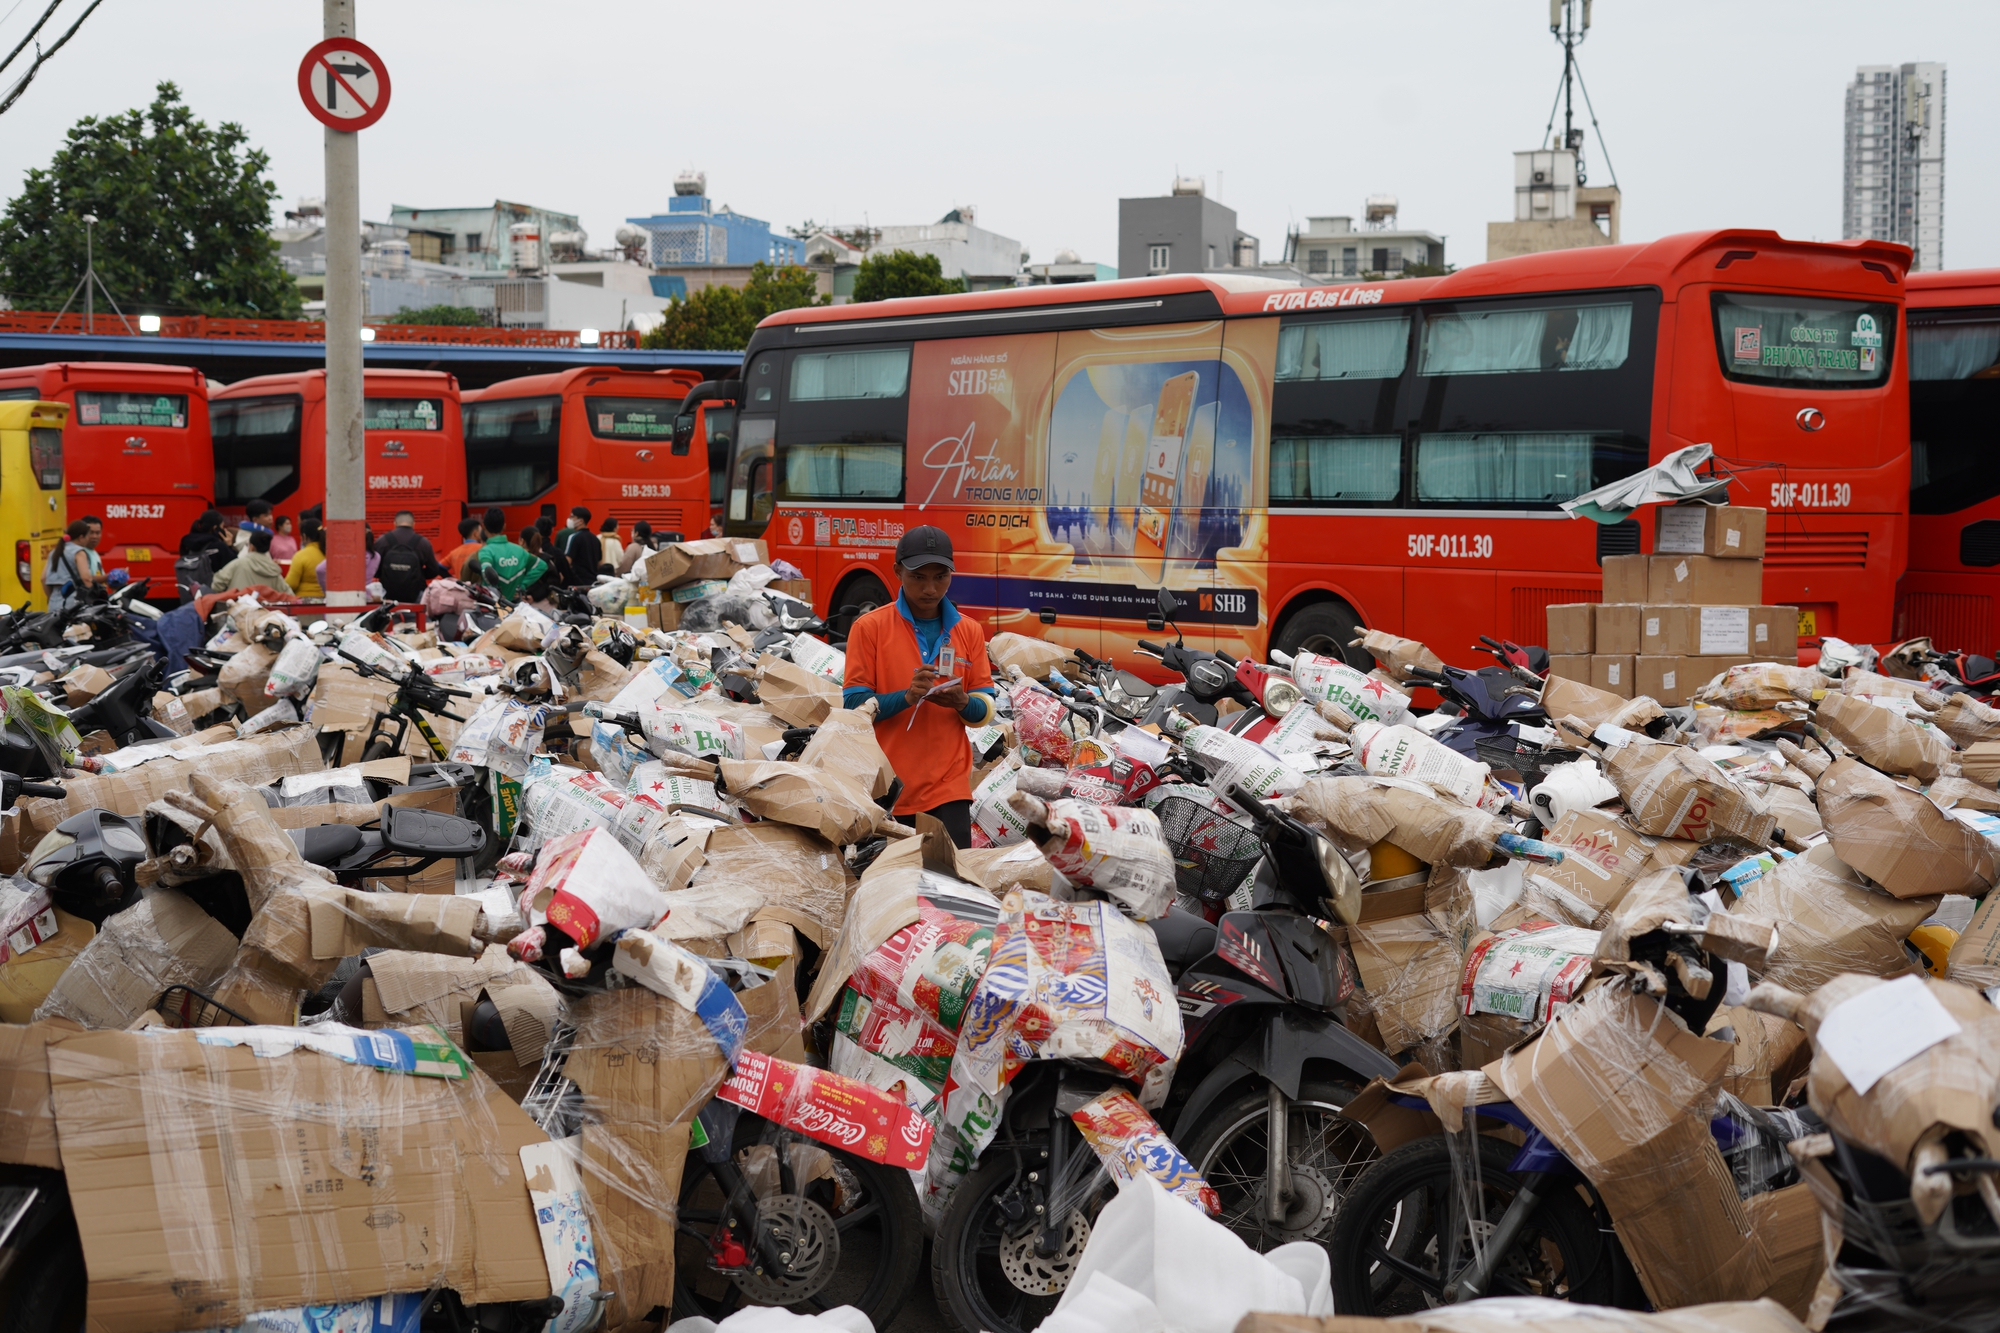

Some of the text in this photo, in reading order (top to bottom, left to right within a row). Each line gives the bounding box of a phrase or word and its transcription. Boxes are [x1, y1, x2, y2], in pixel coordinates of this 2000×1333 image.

[1263, 287, 1384, 311] FUTA Bus Lines
[1790, 324, 1838, 343] CÔNG TY
[1860, 319, 1872, 331] 04
[951, 351, 1008, 365] NGÂN HÀNG SỐ
[1763, 343, 1858, 370] PHƯƠNG TRANG
[948, 369, 987, 396] SHB
[989, 368, 1007, 380] SA
[988, 382, 1005, 394] HA
[974, 438, 1019, 482] tâm
[369, 475, 423, 489] 50H-530.97
[622, 485, 670, 497] 51B-293.30
[965, 488, 1043, 504] TRONG MỌI
[1770, 482, 1851, 507] 50F-011.30
[106, 504, 165, 518] 50H-735.27
[832, 518, 904, 537] FUTA Bus Lines
[965, 514, 1030, 530] GIAO DỊCH
[856, 552, 867, 560] 1900
[1408, 534, 1493, 558] 50F-011.30
[499, 555, 519, 567] Grab
[1045, 591, 1064, 599] SAHA
[1135, 596, 1156, 605] HÀNG
[1214, 593, 1247, 613] SHB
[508, 718, 527, 745] Tiger
[1241, 765, 1266, 789] SILVER
[503, 787, 517, 818] LARUE
[1634, 778, 1656, 808] KHÔNG
[1571, 831, 1619, 870] laVie
[1490, 992, 1522, 1013] COOLPACK
[978, 1050, 1002, 1076] CRYSTAL
[901, 1113, 927, 1147] Coca
[335, 1178, 344, 1192] PCS
[562, 1286, 582, 1331] AQUAFINA
